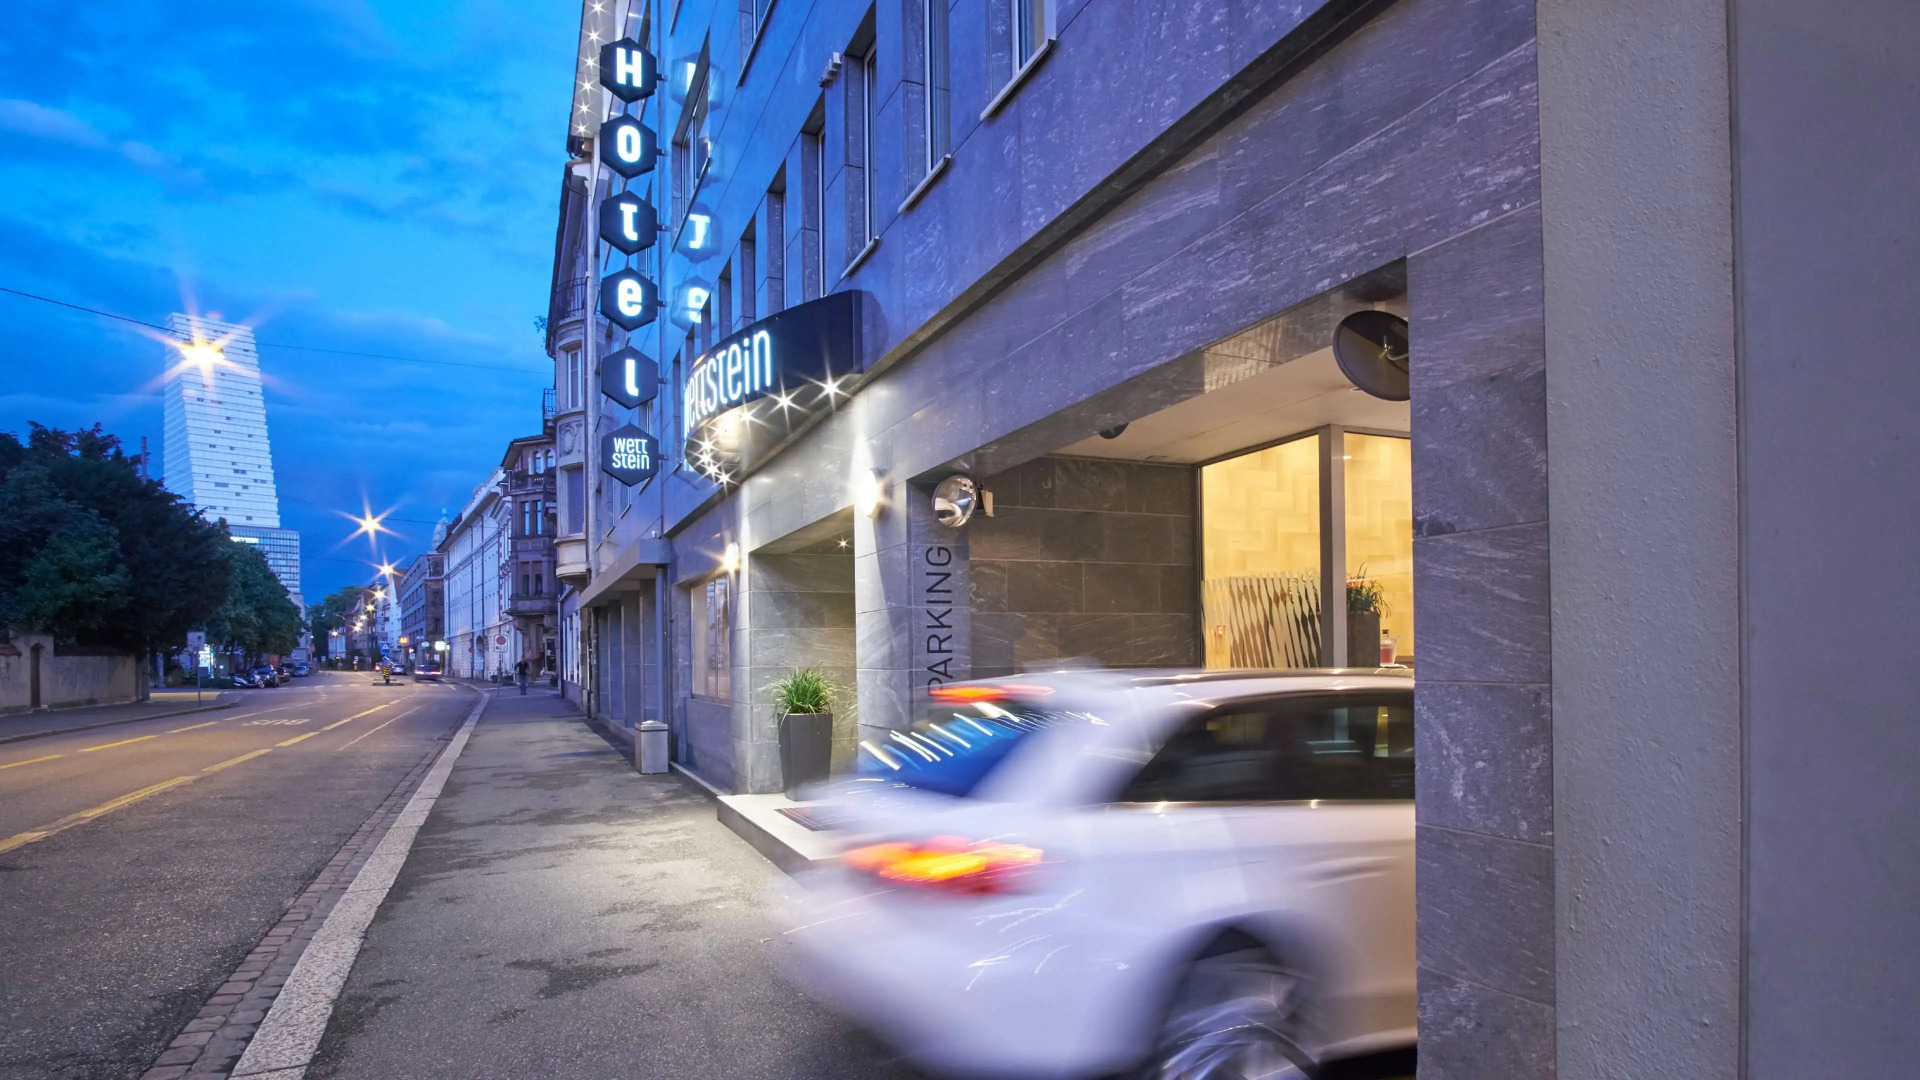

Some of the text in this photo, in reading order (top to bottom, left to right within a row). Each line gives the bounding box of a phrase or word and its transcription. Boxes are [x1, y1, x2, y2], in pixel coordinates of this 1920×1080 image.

[613, 437, 648, 454] wett
[612, 452, 650, 470] stein
[925, 545, 953, 696] PARKING
